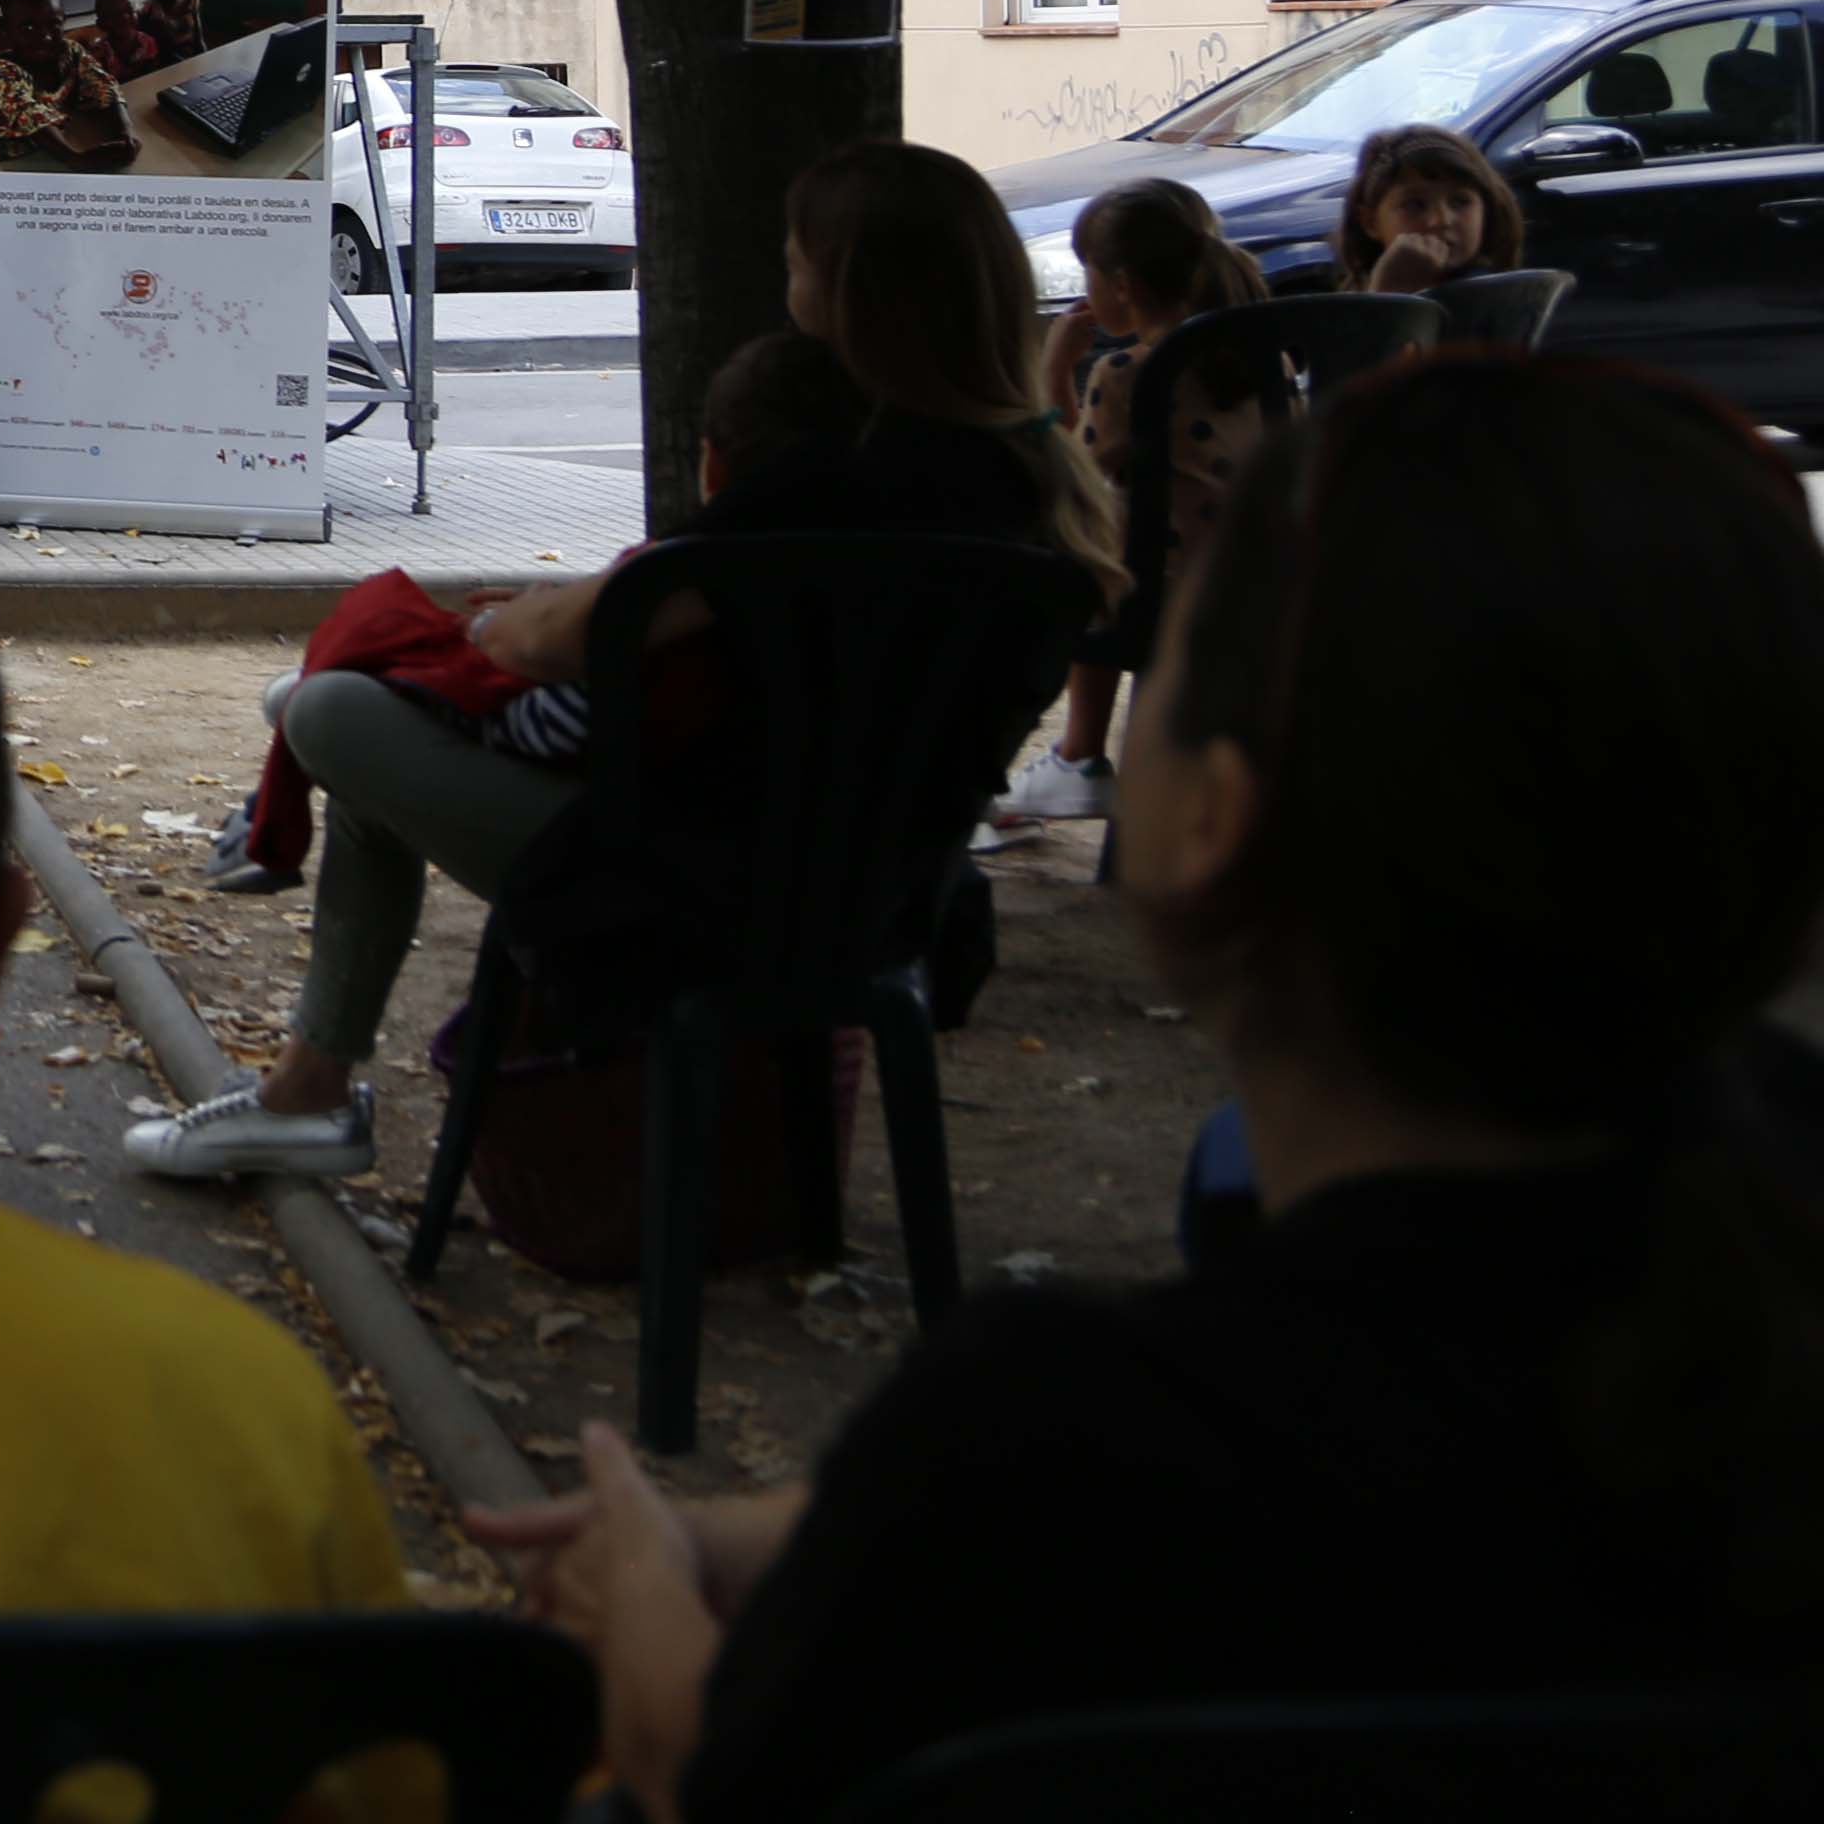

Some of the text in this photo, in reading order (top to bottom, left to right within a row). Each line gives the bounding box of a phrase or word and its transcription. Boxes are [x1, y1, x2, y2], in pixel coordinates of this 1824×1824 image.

[0, 191, 35, 202] aquest
[37, 191, 61, 202] punt
[64, 192, 87, 203] pots
[89, 192, 122, 203] deixar
[125, 193, 135, 203] el
[244, 197, 259, 207] en
[301, 197, 311, 209] A
[13, 204, 27, 215] de
[75, 206, 107, 219] global
[39, 221, 79, 233] segona
[81, 221, 103, 232] vida
[503, 212, 579, 229] 3241 DKB
